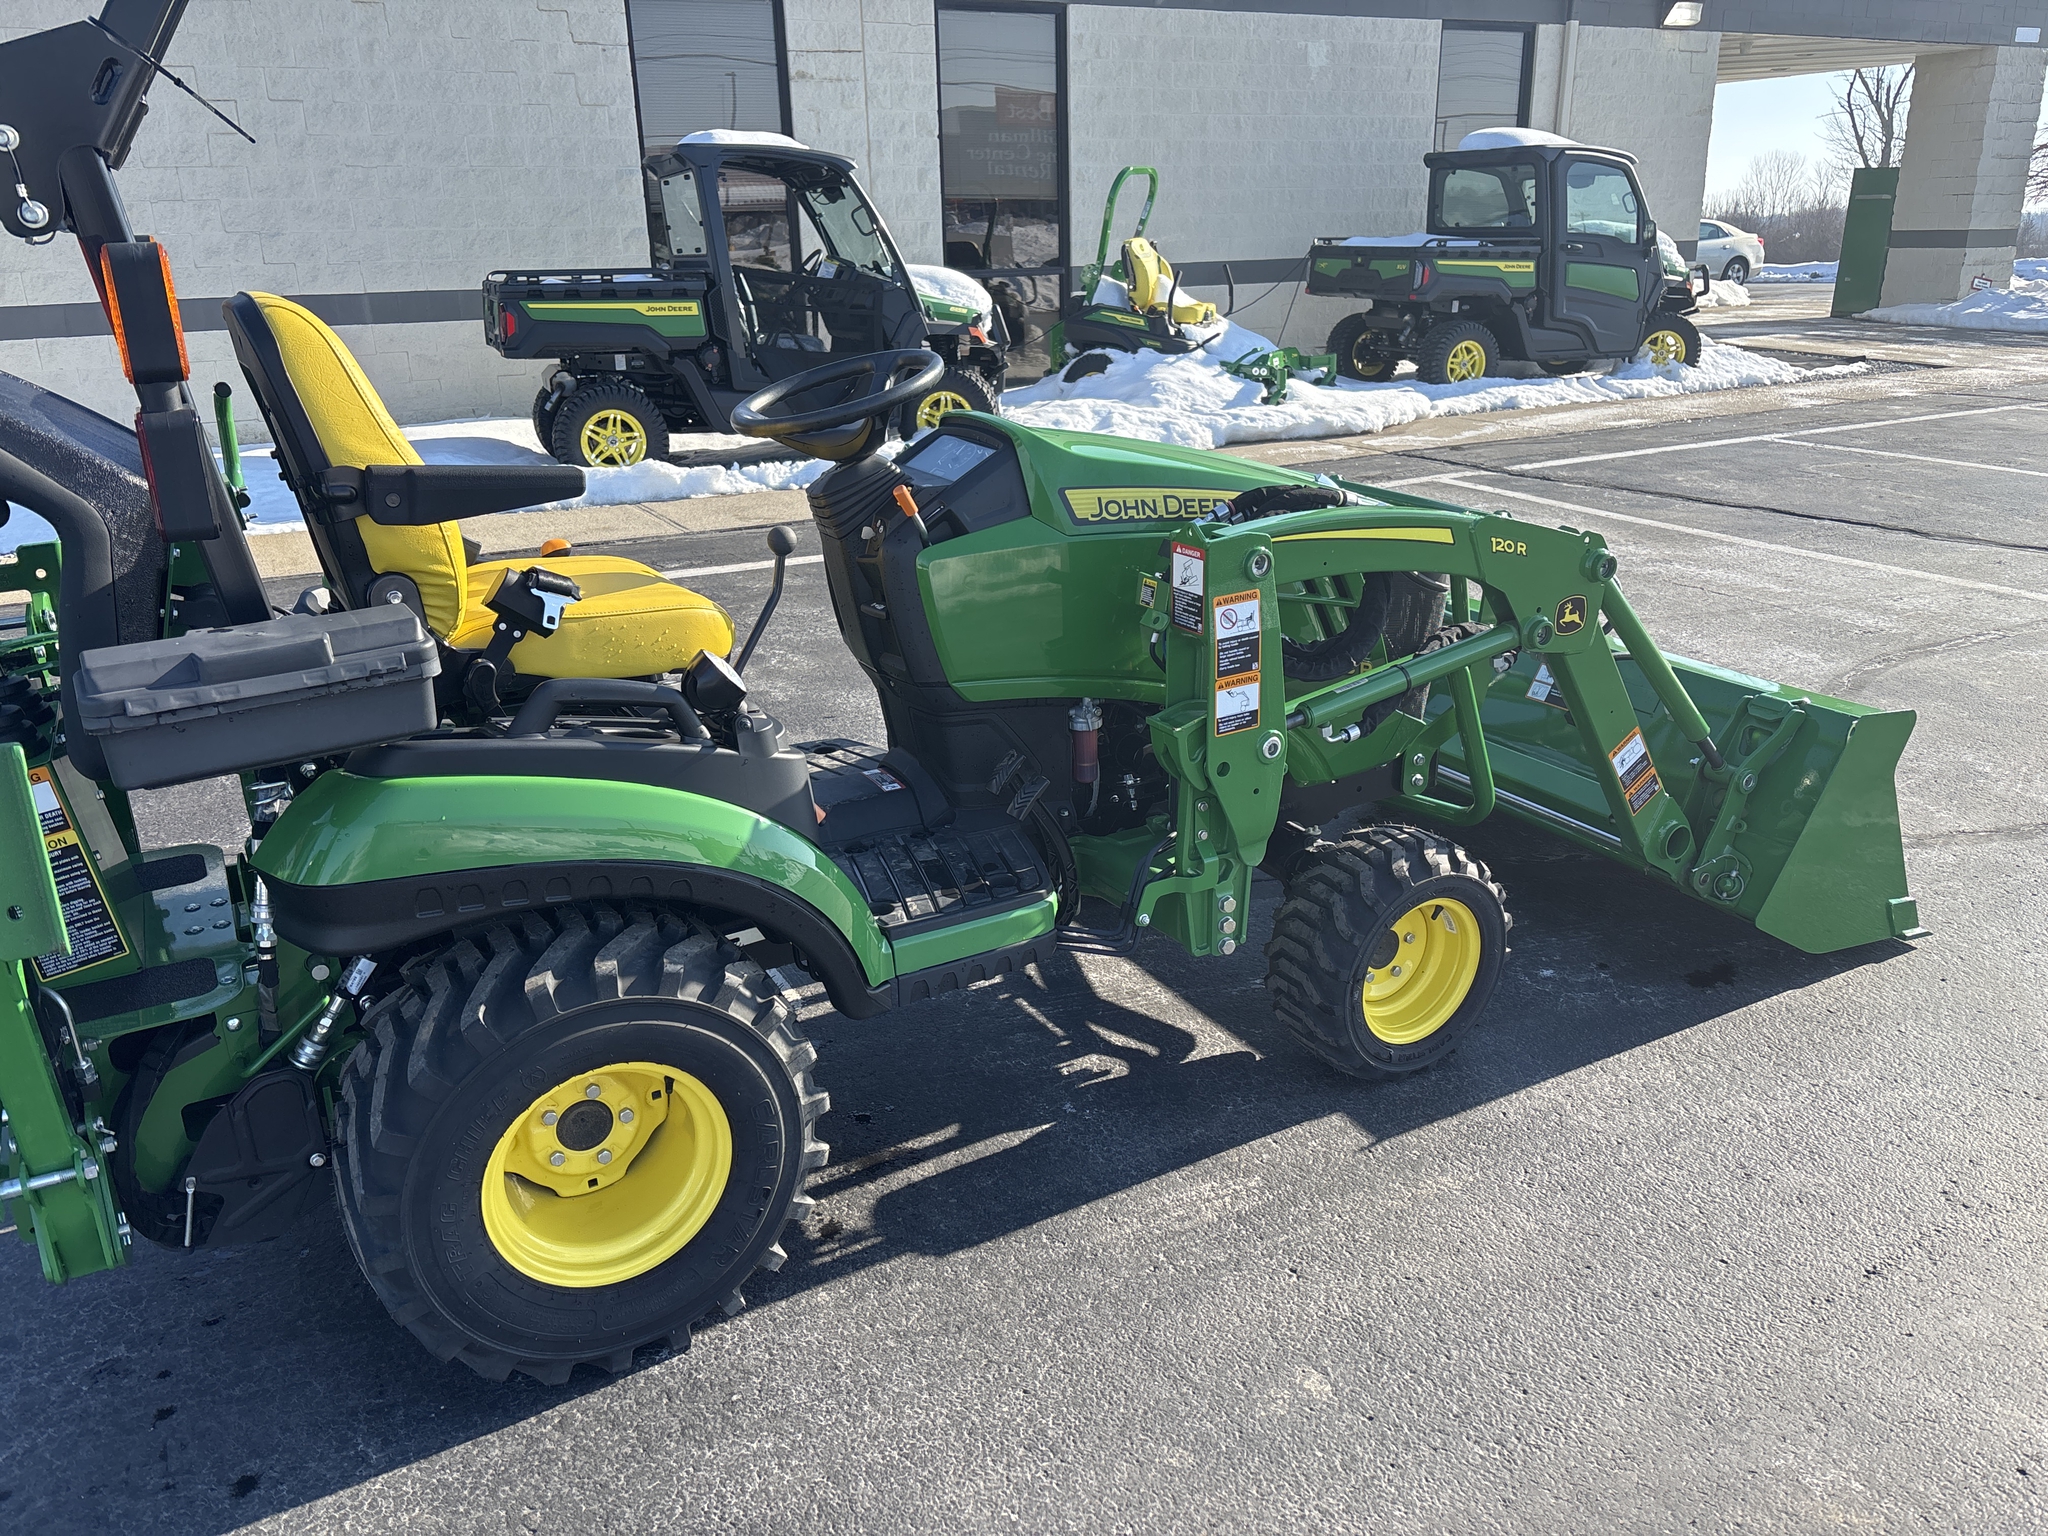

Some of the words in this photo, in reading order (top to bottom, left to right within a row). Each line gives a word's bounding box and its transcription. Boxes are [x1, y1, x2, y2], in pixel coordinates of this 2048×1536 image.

[1090, 496, 1158, 519] JOHN
[1181, 547, 1201, 558] DANGER
[1490, 537, 1515, 553] 120
[1517, 542, 1527, 556] R
[1222, 591, 1258, 604] WARNING
[1224, 674, 1259, 688] WARNING
[44, 810, 63, 819] DEATH
[48, 849, 62, 858] JURY
[447, 1094, 509, 1182] CHIEF
[440, 1202, 475, 1283] TRAC
